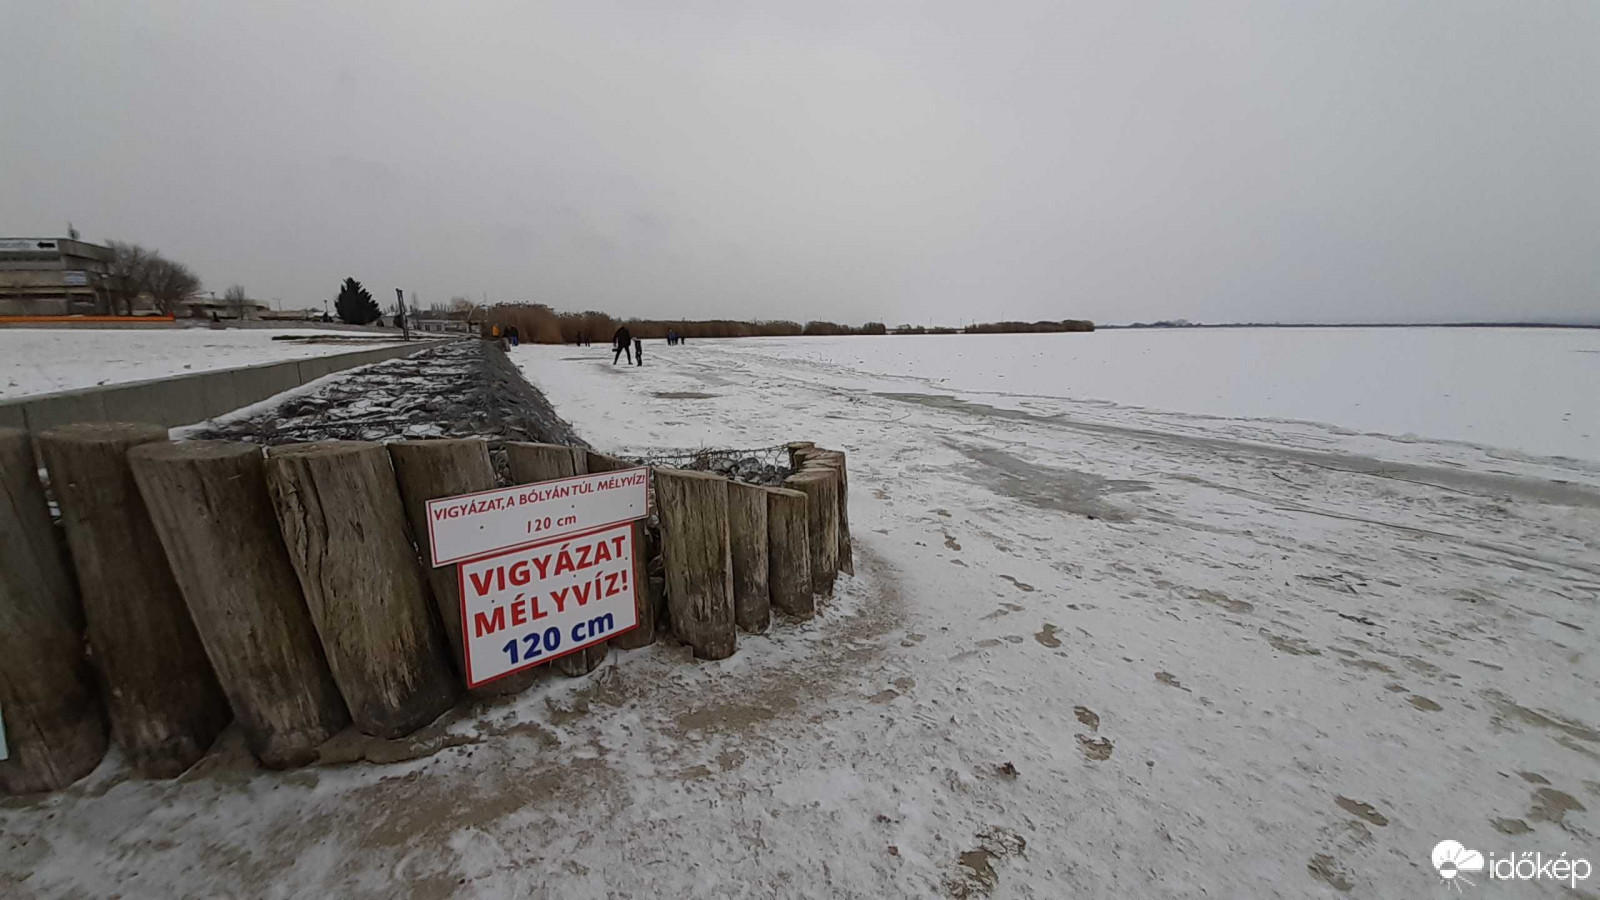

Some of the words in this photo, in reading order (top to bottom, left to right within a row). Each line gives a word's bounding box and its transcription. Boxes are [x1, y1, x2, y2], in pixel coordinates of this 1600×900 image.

[597, 473, 645, 491] MÉLYVÍZ!
[527, 517, 551, 533] 120
[557, 514, 577, 526] cm
[469, 535, 626, 597] VIGYÁZAT
[474, 569, 628, 638] MÉLYVÍZ!
[502, 626, 561, 665] 120
[571, 612, 614, 642] cm
